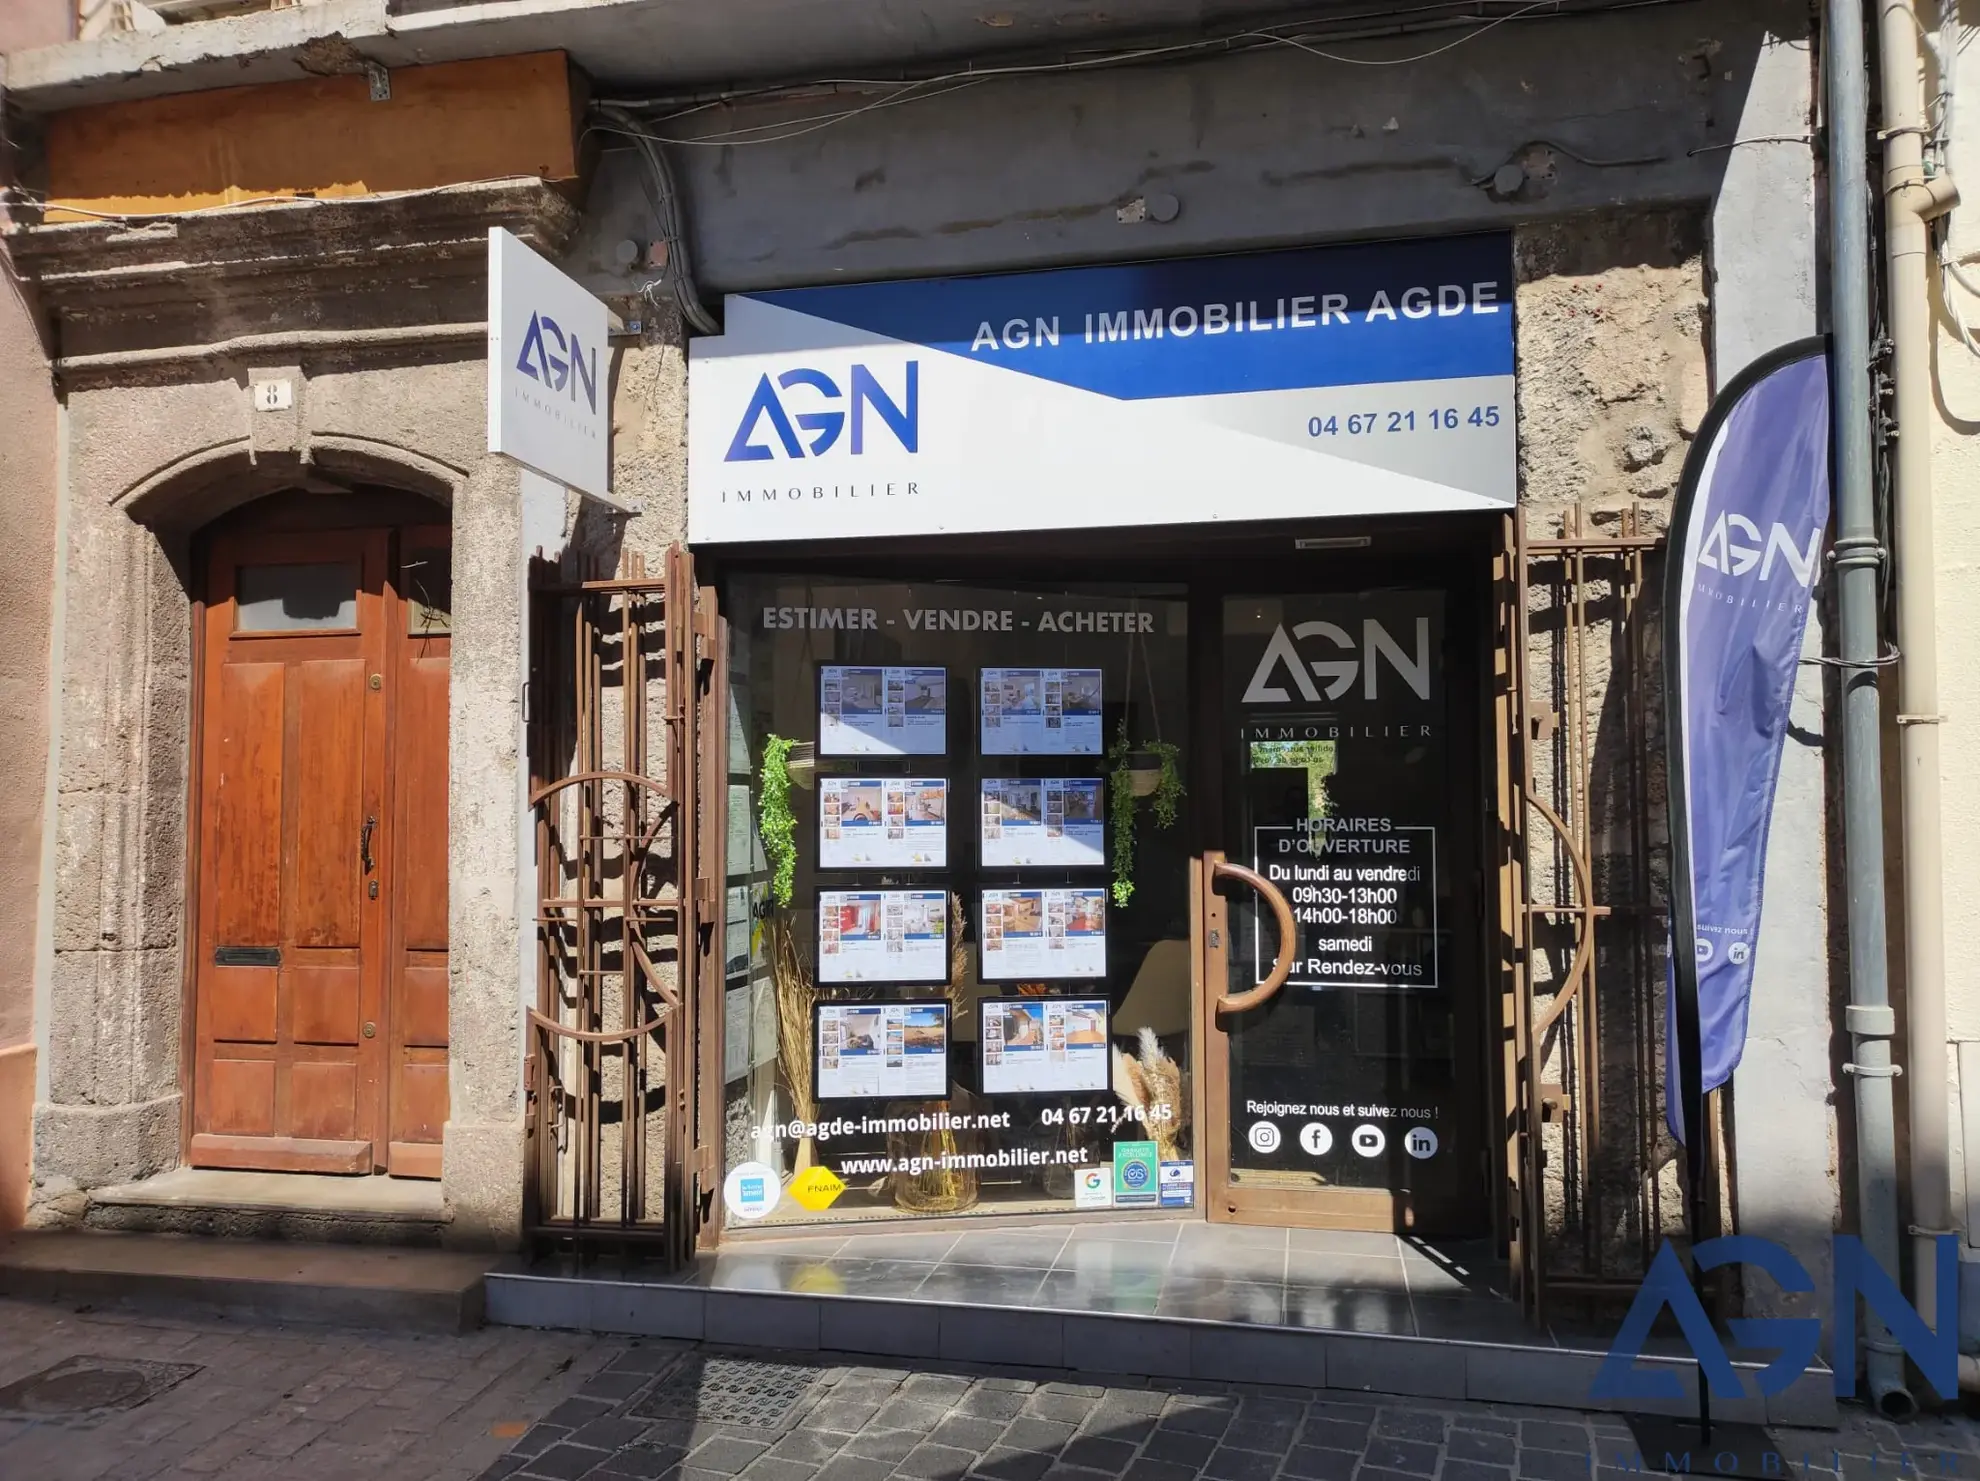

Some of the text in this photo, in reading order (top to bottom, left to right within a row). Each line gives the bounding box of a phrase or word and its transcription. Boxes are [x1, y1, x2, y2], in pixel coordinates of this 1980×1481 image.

[971, 281, 1499, 352] AGN IMMOBILIER AGDE
[516, 309, 596, 415] AGN
[266, 384, 278, 405] 8
[723, 360, 919, 462] AGN
[1308, 405, 1500, 438] 04 67 21 16 45
[722, 482, 919, 503] IMMOBILIER
[1698, 509, 1821, 588] AGN
[1698, 584, 1803, 613] MMOBILIER
[763, 607, 878, 630] ESTIMER
[903, 608, 1013, 631] VENDRE
[1037, 611, 1155, 633] ACHETER
[1241, 617, 1430, 703] AGN
[1240, 725, 1431, 740] IMMOBILIER
[1296, 818, 1391, 833] HORAIRES
[1278, 839, 1411, 854] D'OUVERTURE
[1269, 864, 1421, 882] Du lundi au vendredi
[1292, 887, 1397, 904] 09h30-13h00
[1293, 907, 1397, 925] 14h00-18h00
[1318, 936, 1373, 952] samedi
[1307, 958, 1423, 976] Rendez-vous
[1041, 1103, 1172, 1125] 04 67 21 16 45
[1246, 1100, 1306, 1117] Rejoignez
[1309, 1104, 1340, 1116] nous
[1342, 1104, 1355, 1116] et
[1357, 1104, 1397, 1118] suivez
[1400, 1107, 1431, 1119] nous
[841, 1146, 1088, 1176] www.agn-immobilier.net
[807, 1183, 841, 1194] FNAIM
